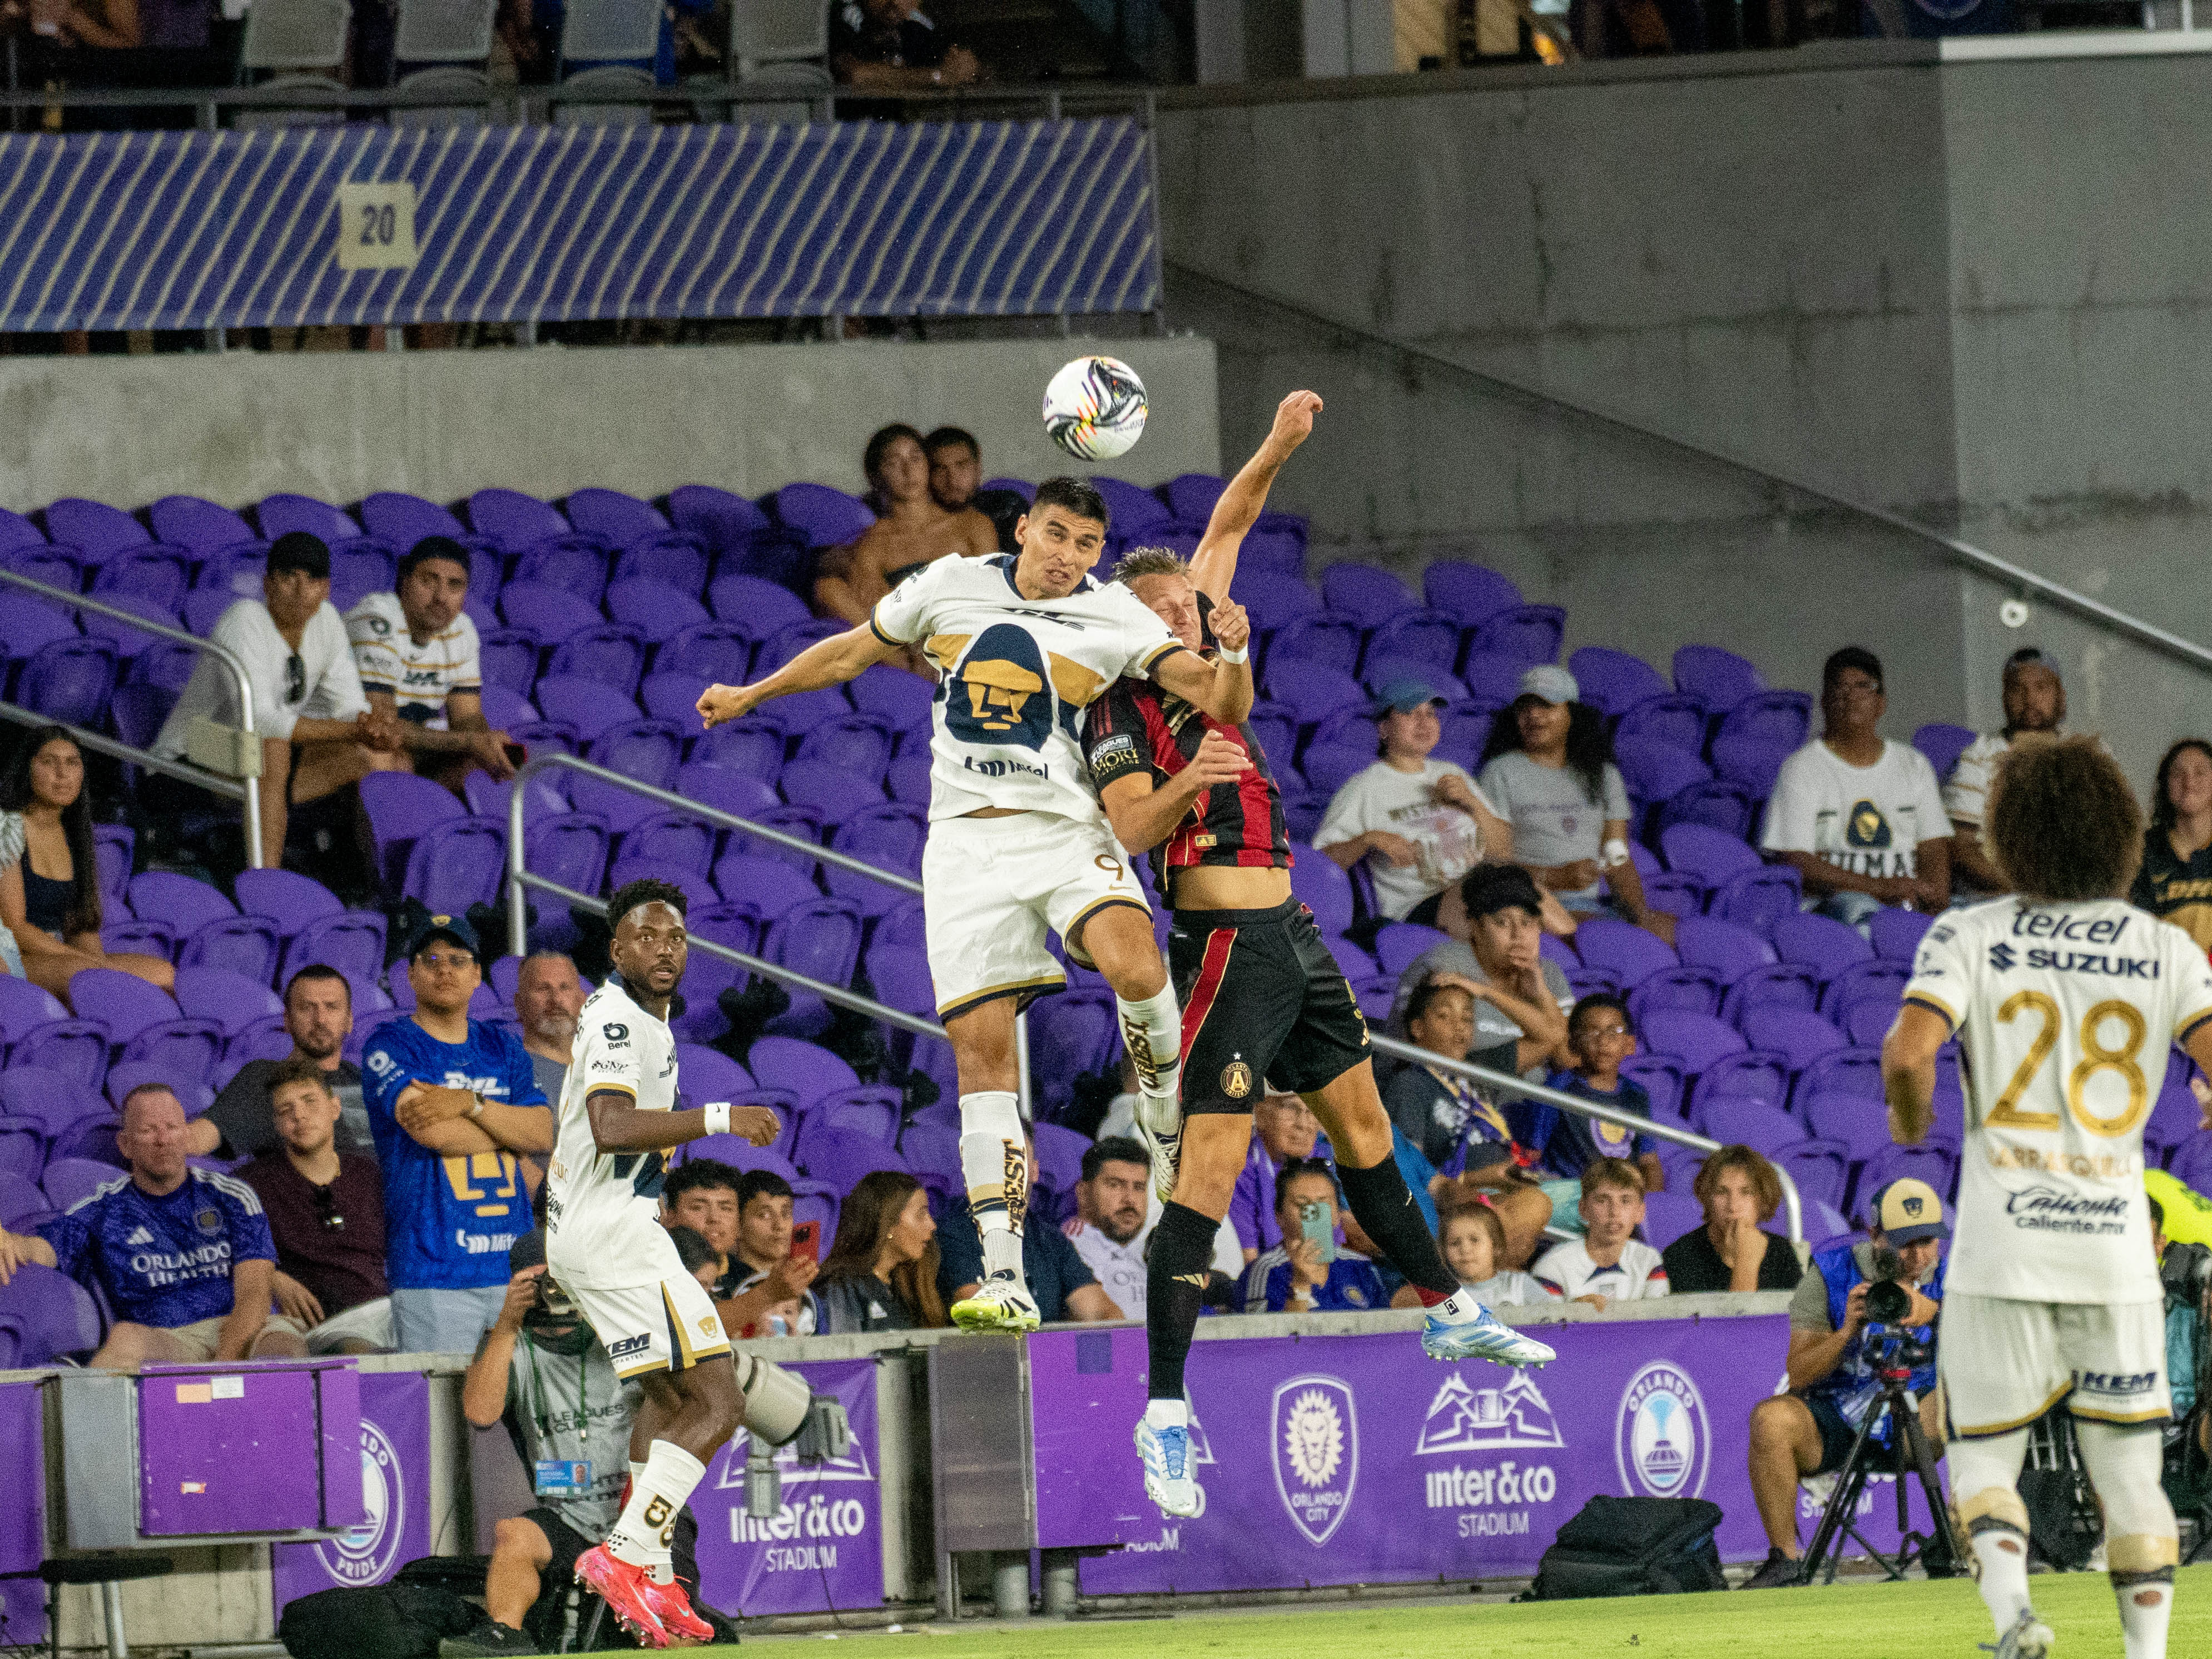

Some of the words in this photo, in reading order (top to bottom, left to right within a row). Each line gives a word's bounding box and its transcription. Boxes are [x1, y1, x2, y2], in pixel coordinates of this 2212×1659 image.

[361, 204, 396, 246] 20
[1095, 737, 1129, 753] LEAGUES
[1094, 854, 1124, 881] 9
[2012, 907, 2130, 945] telcel
[2027, 948, 2160, 980] SUZUKI
[608, 1040, 631, 1050] Berel
[1981, 989, 2148, 1139] 28
[131, 1240, 231, 1273] ORLANDO
[1628, 1373, 1695, 1413] ORLANDO
[2085, 1370, 2158, 1391] KEM
[1292, 1491, 1343, 1508] ORLANDO
[1306, 1507, 1329, 1522] CITY
[1458, 1511, 1530, 1538] STADIUM
[336, 1556, 376, 1578] PRIDE
[765, 1545, 837, 1573] STADIUM
